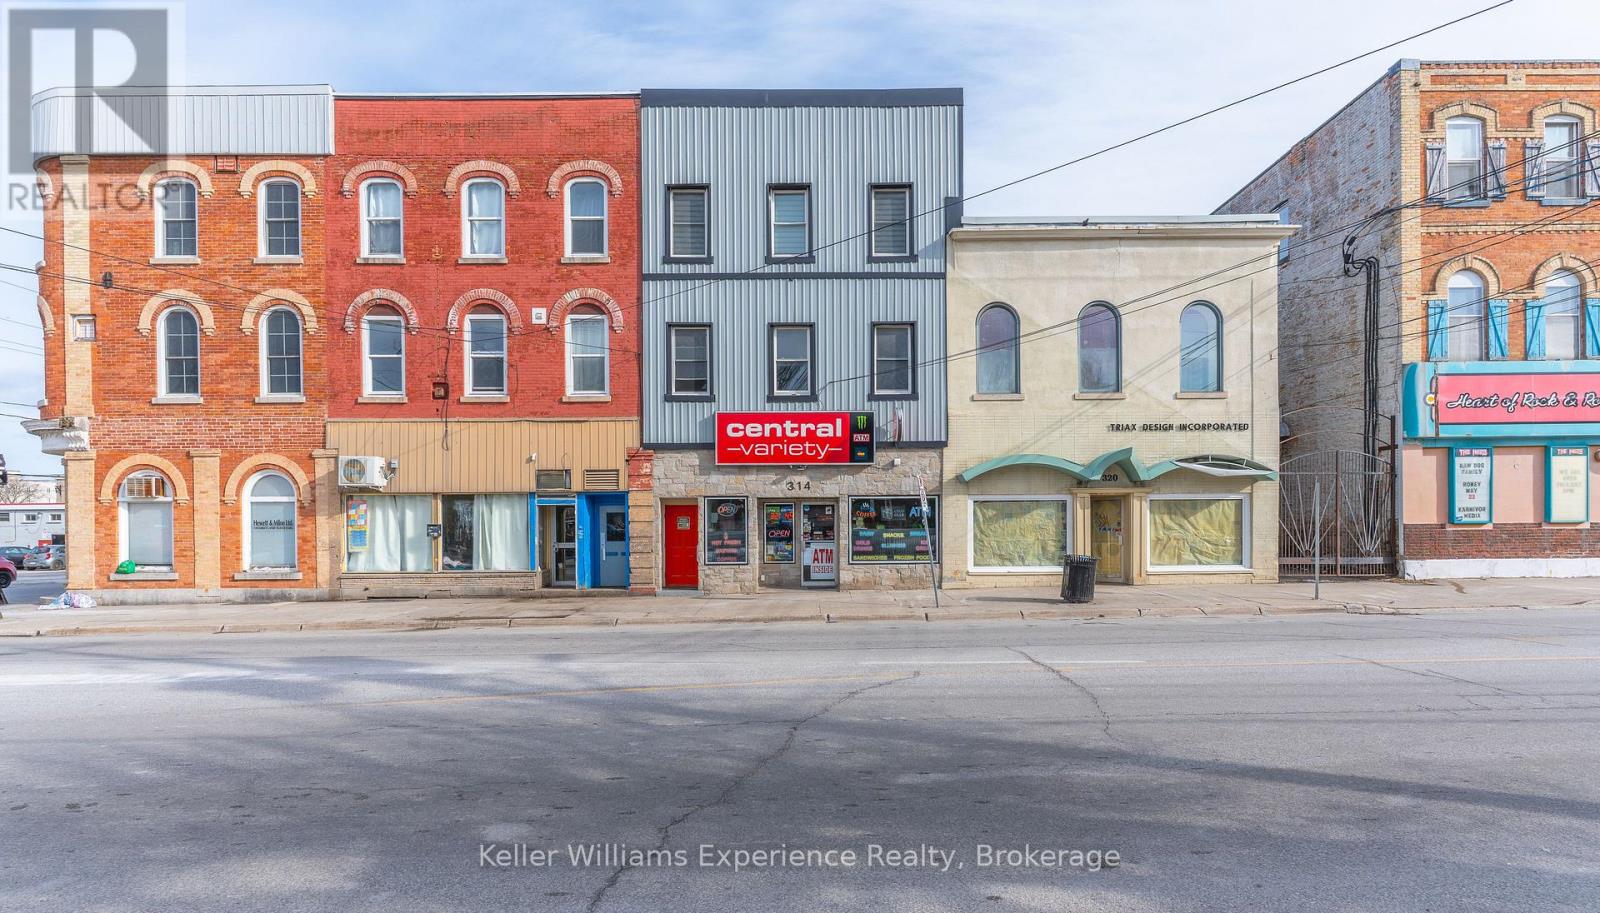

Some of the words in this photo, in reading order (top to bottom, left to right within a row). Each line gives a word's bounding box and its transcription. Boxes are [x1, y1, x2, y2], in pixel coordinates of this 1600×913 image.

[1447, 393, 1500, 408] Heart
[1501, 391, 1520, 413] of
[1522, 392, 1559, 410] Rock
[1563, 393, 1578, 408] &
[726, 418, 842, 438] central
[1110, 423, 1137, 431] TRIAX
[1143, 423, 1174, 431] DESIGN
[1179, 422, 1249, 431] INCORPORATED
[853, 433, 870, 442] ATM
[740, 440, 829, 460] variety
[1102, 474, 1118, 482] 320
[786, 481, 811, 491] 314
[718, 505, 737, 513] OPEN
[768, 529, 791, 538] OPEN
[812, 548, 834, 564] ATM
